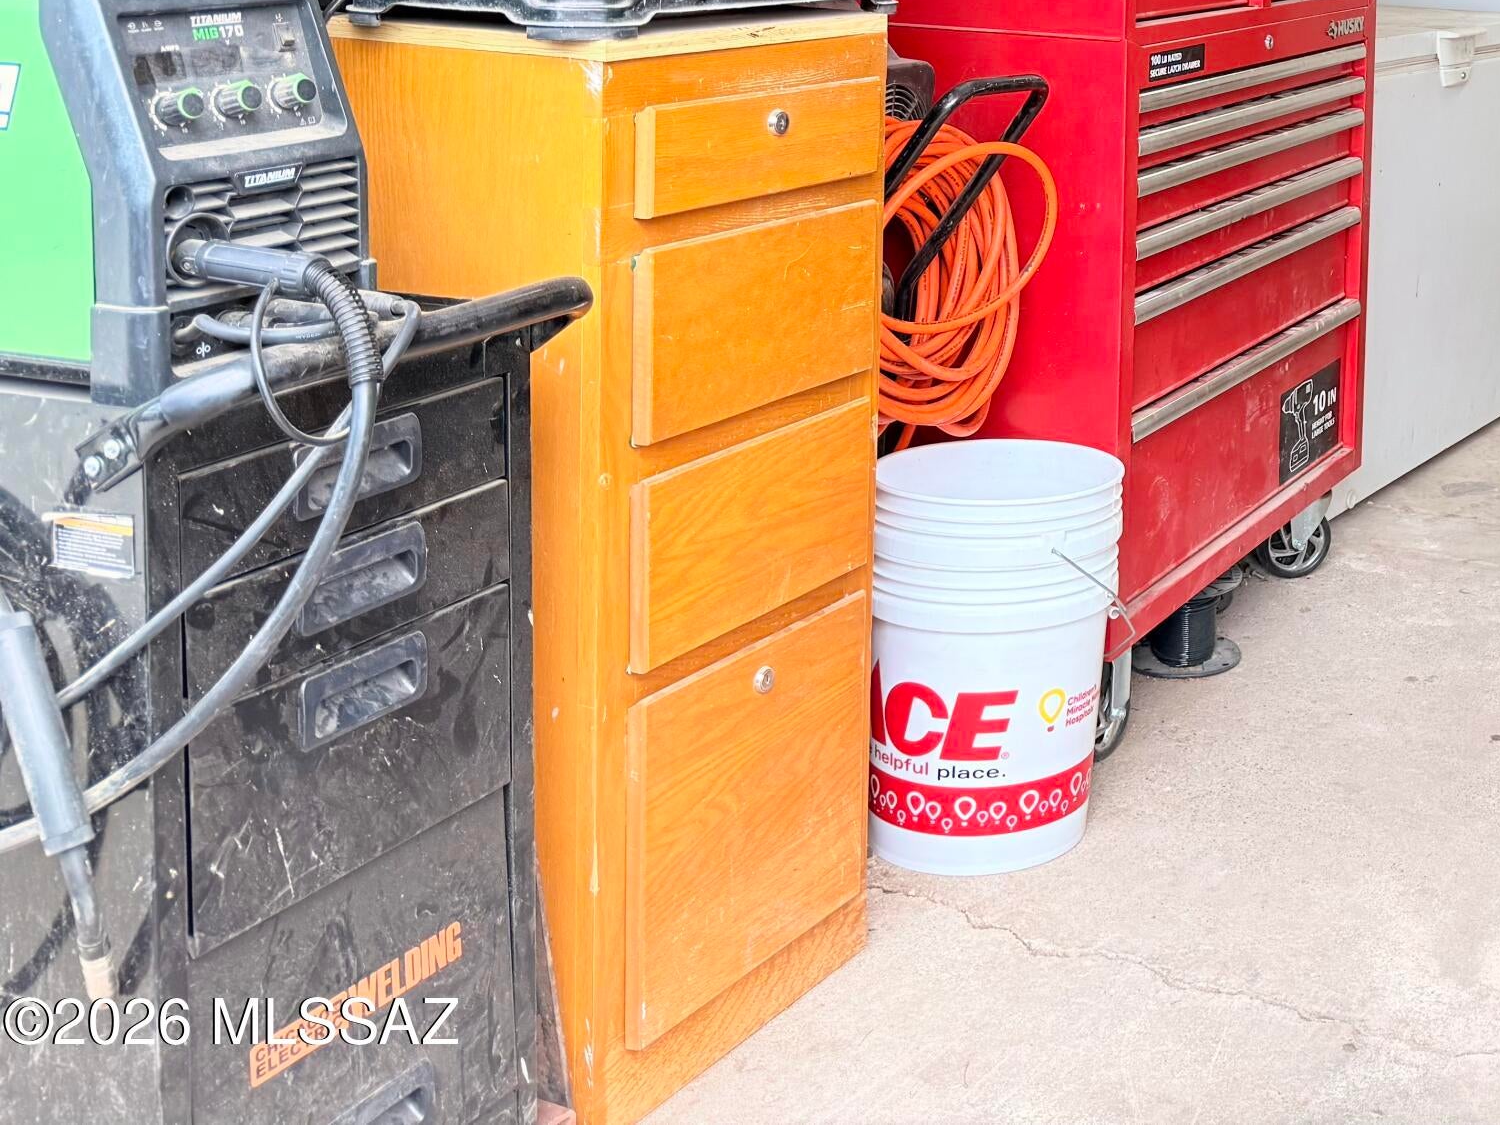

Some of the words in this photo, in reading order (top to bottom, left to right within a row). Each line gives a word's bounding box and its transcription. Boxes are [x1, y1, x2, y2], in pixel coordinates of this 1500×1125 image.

[189, 12, 242, 27] TITANIUM
[1337, 16, 1365, 37] HUSKY
[244, 167, 295, 187] TITANIUM
[1312, 390, 1326, 415] 10
[1327, 386, 1337, 407] IN
[873, 743, 928, 776] helpful
[937, 765, 1006, 781] place.
[349, 921, 463, 1018] WELDING
